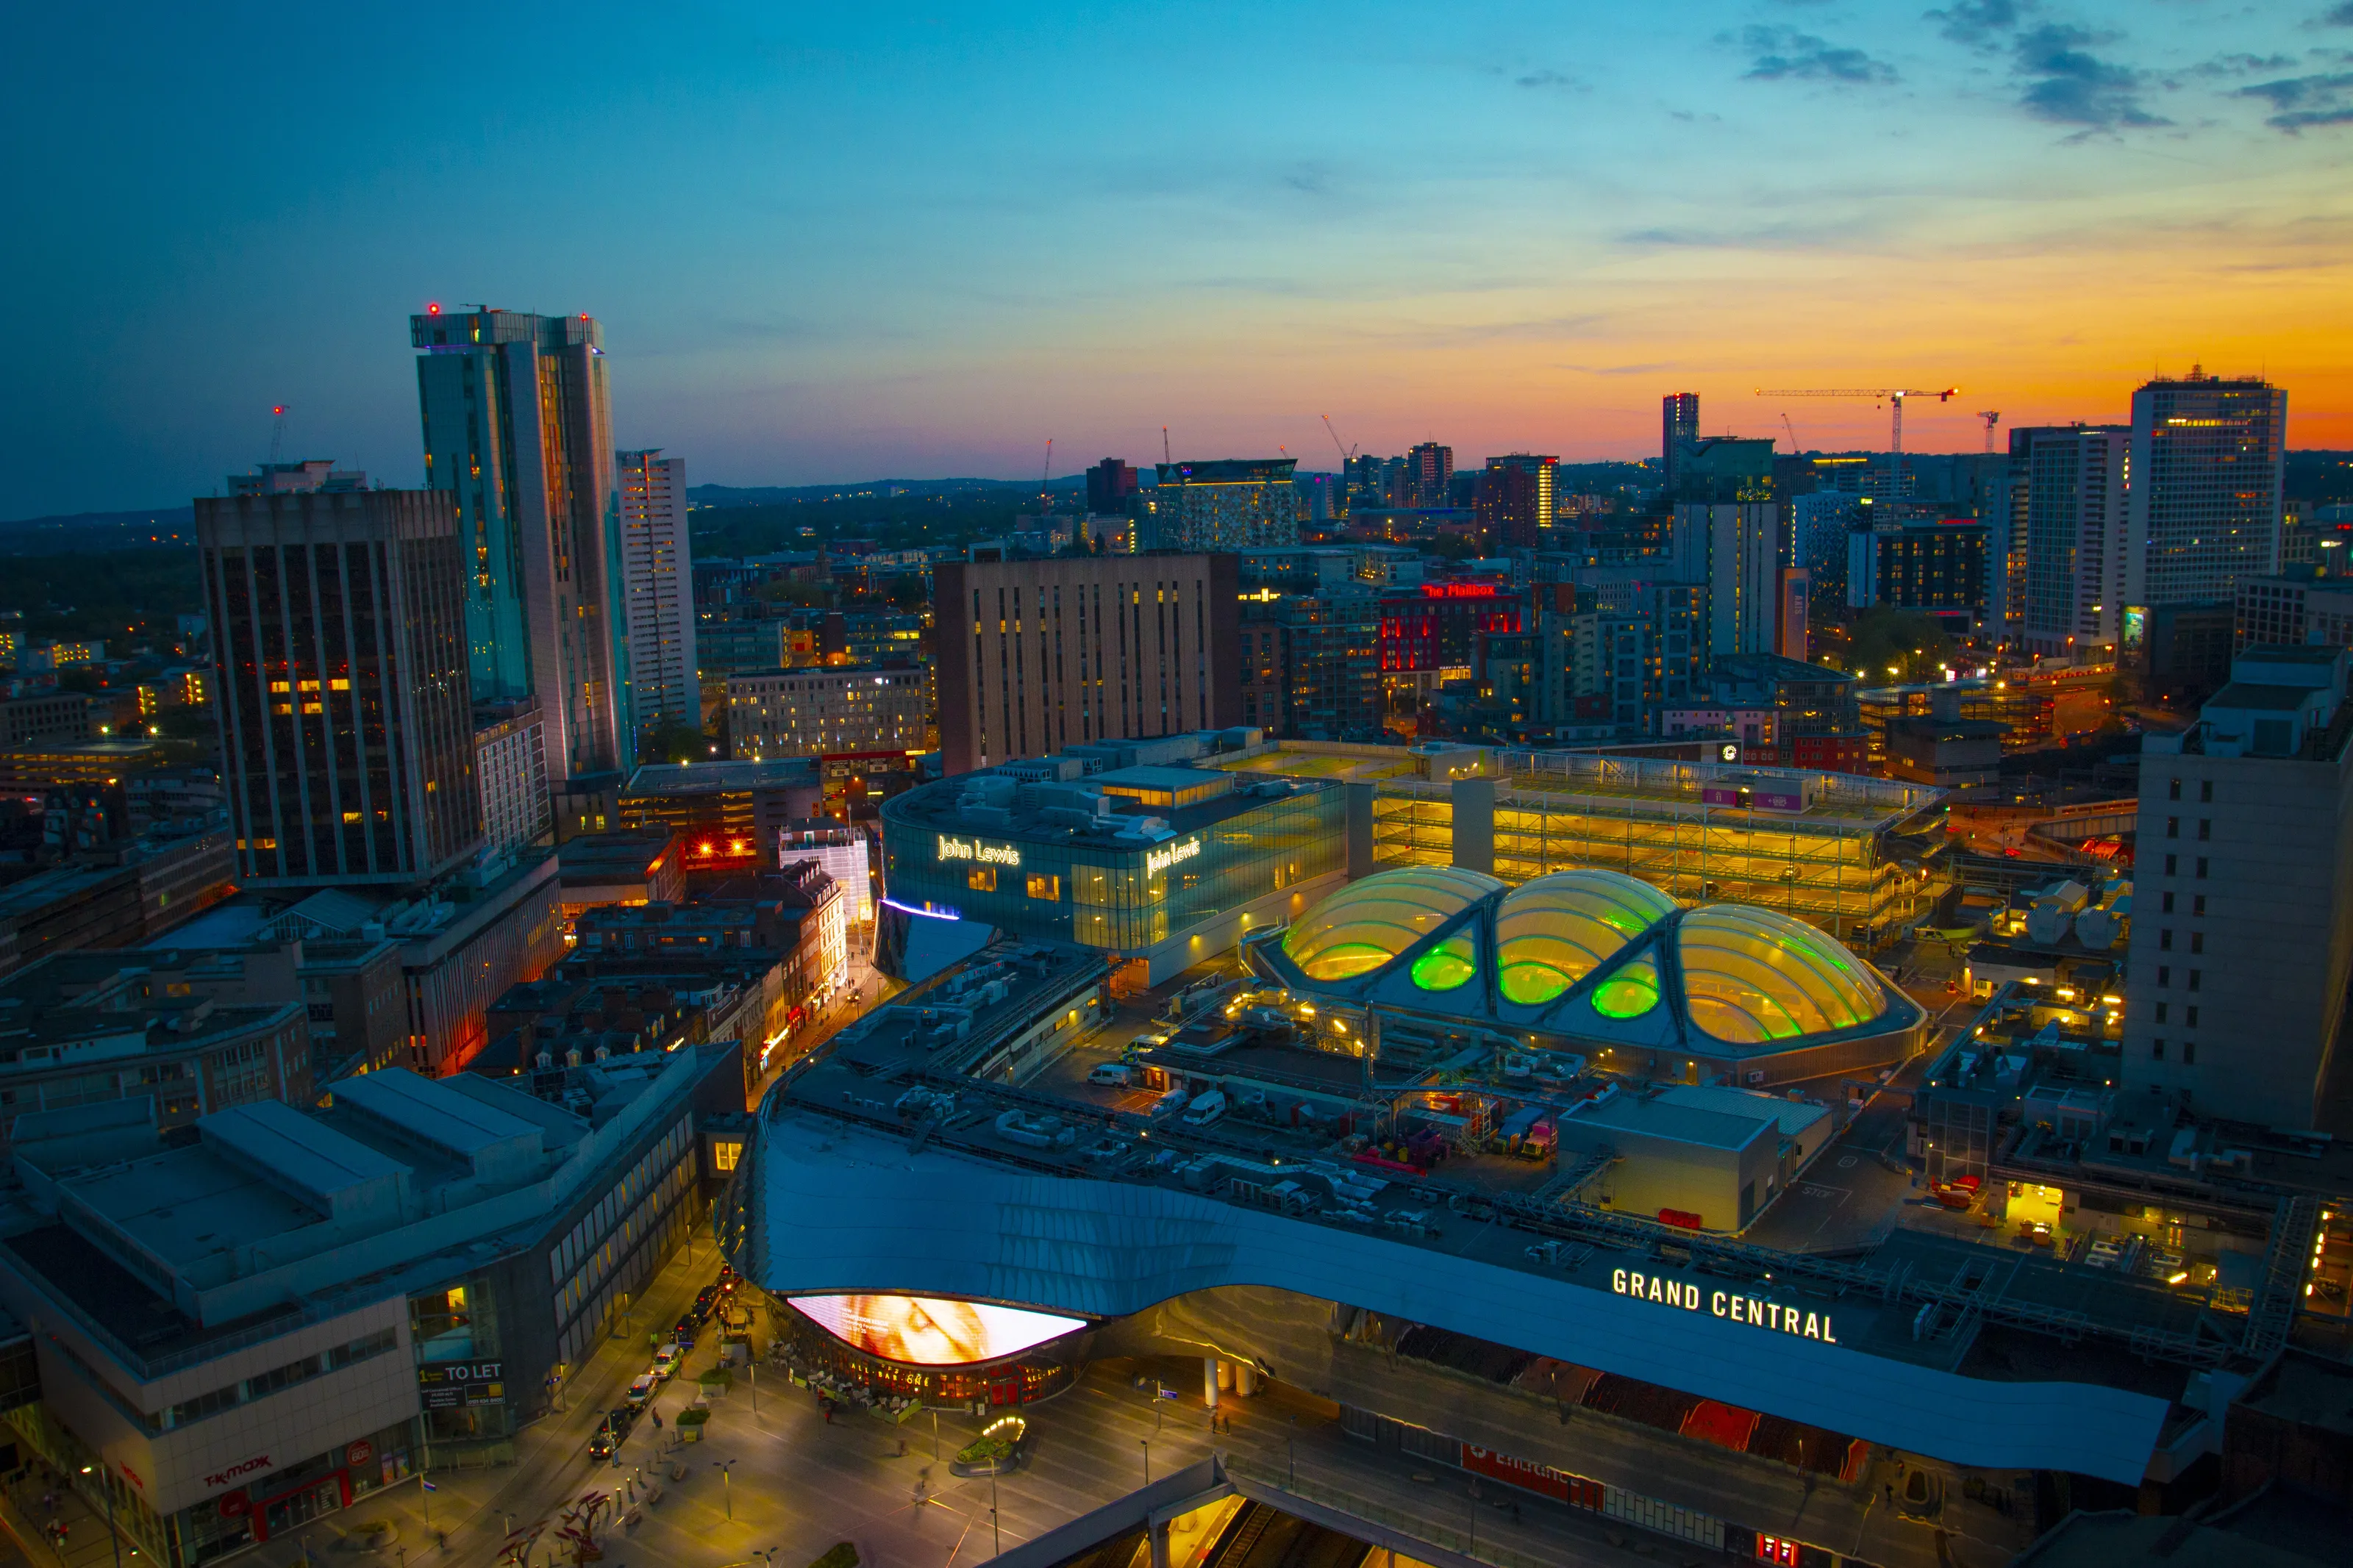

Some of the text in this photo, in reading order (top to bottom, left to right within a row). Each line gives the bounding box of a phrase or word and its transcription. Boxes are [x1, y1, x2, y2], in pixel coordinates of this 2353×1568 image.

[1421, 584, 1495, 598] The Mailbox
[1795, 595, 1803, 615] AXIS
[938, 835, 1020, 865] John Lewis
[1146, 836, 1201, 879] John Lewis
[1802, 1186, 1835, 1198] STOP
[1613, 1268, 1837, 1344] GRAND CENTRAL
[445, 1367, 469, 1381] TO
[471, 1364, 501, 1378] LET
